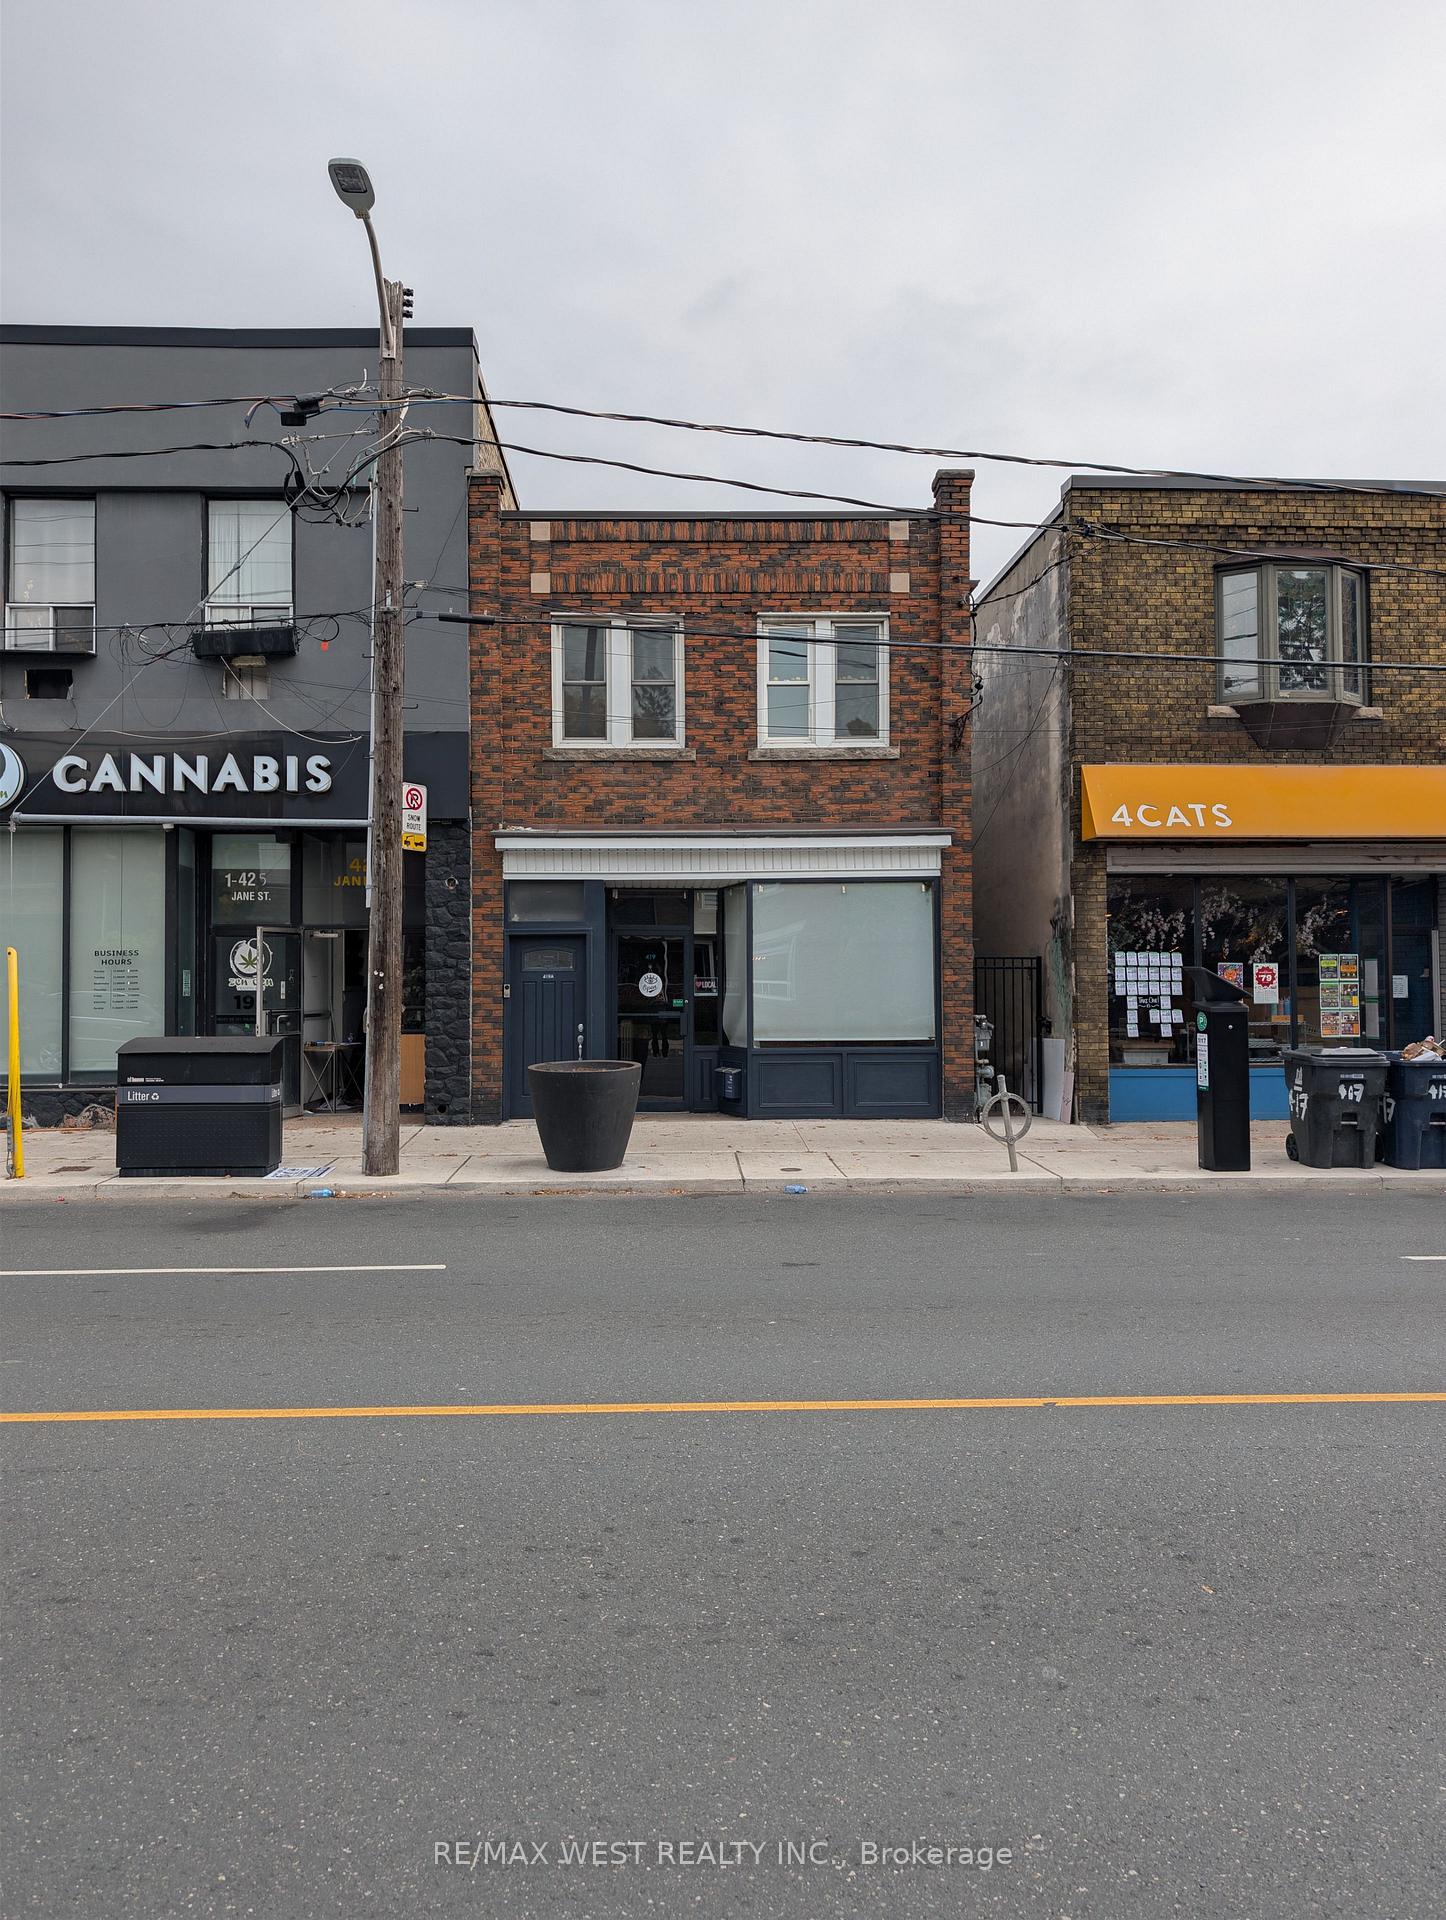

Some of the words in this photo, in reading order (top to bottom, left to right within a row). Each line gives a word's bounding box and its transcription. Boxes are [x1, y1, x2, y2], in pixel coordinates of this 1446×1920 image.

[52, 752, 332, 794] CANNABIS
[407, 814, 421, 822] SNOW
[1111, 803, 1233, 828] 4CATS
[406, 822, 421, 831] ROUTE
[231, 891, 255, 901] JANE
[257, 891, 271, 901] ST.
[127, 1091, 149, 1101] Litter
